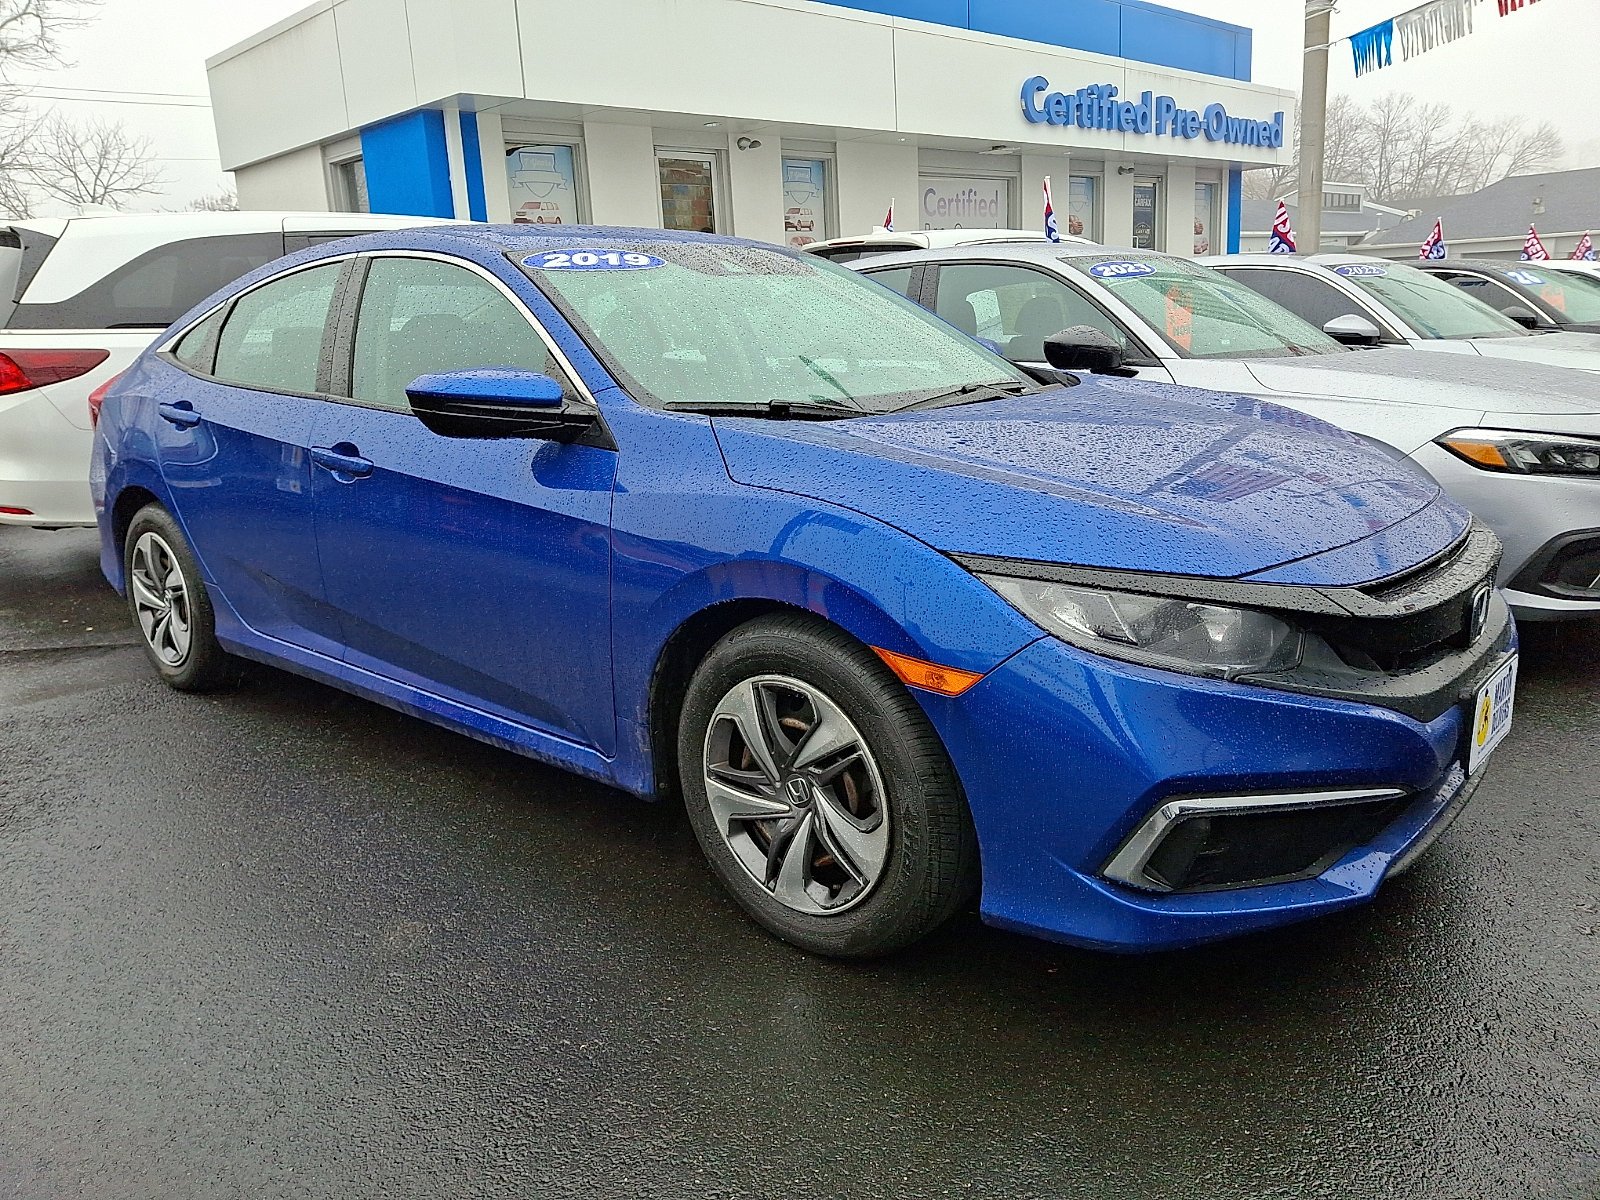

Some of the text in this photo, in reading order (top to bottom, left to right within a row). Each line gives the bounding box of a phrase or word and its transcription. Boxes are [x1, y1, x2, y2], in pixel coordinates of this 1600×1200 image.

[1020, 75, 1285, 149] Certified Pre-Owned
[923, 187, 999, 217] Certified
[1134, 198, 1152, 207] CARFAX
[542, 252, 650, 268] 2019
[1096, 261, 1150, 277] 2023
[1344, 264, 1380, 276] 2022
